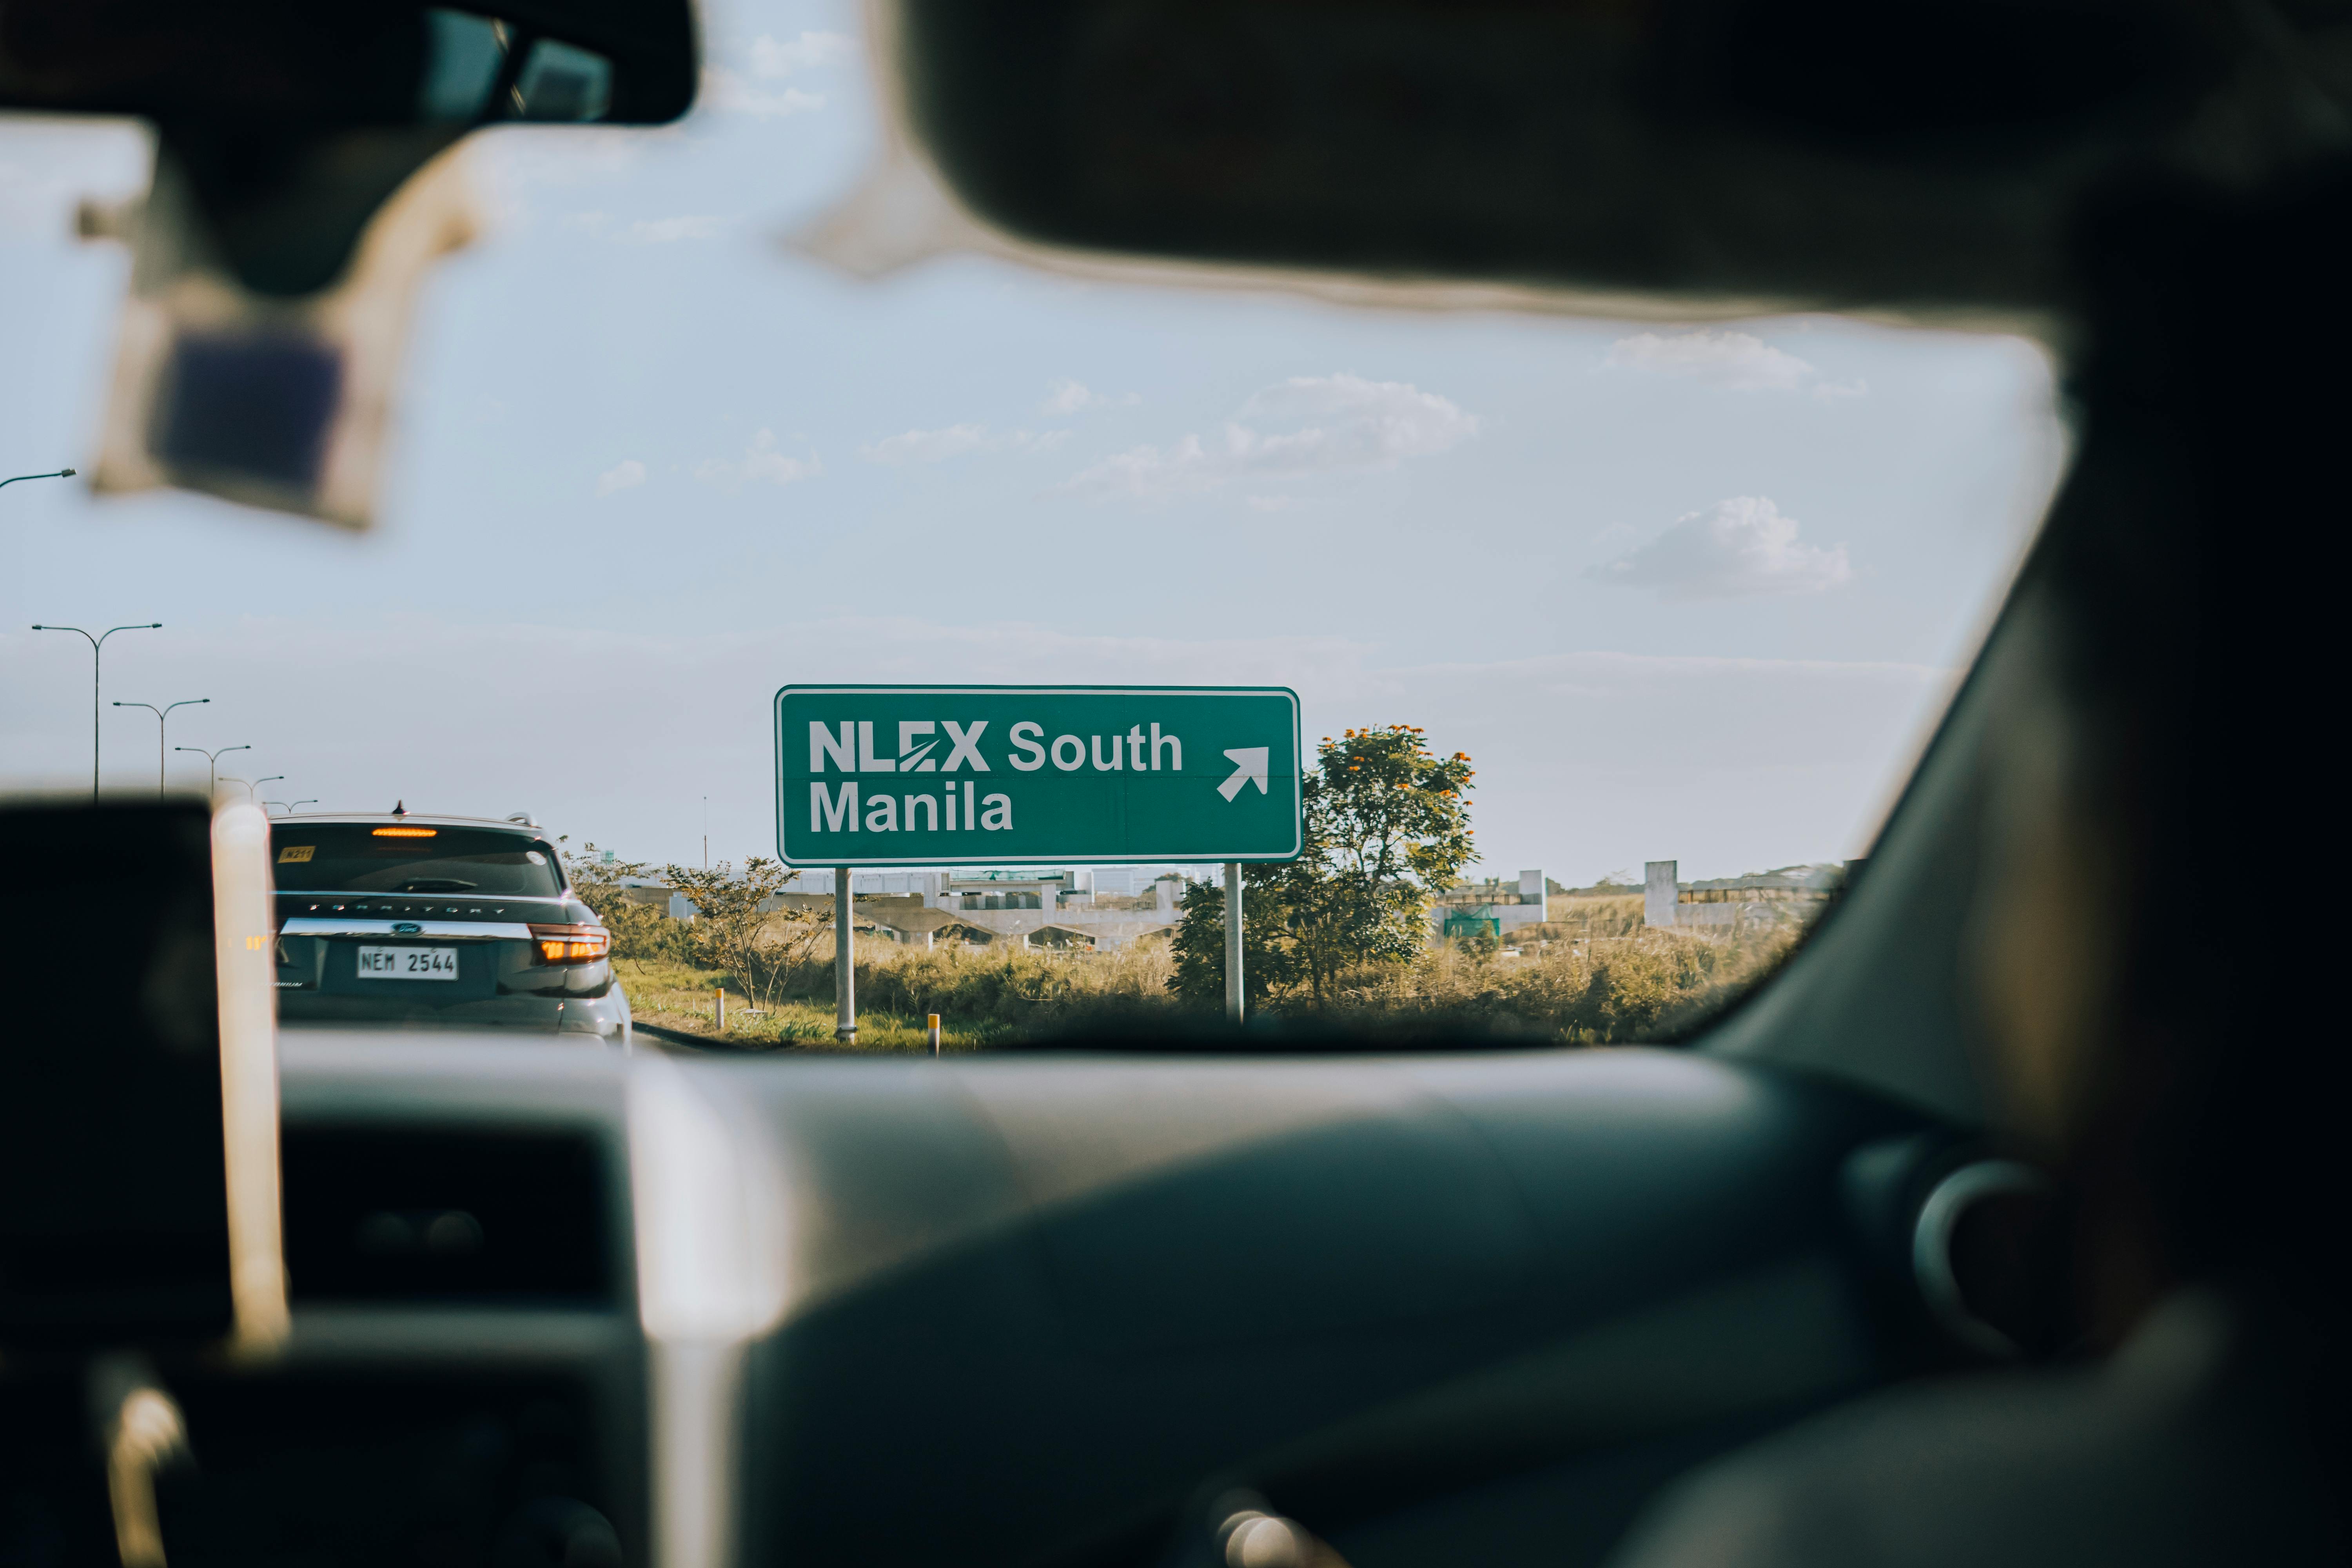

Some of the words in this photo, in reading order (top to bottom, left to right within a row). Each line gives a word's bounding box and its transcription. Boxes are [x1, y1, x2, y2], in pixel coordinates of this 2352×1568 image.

[809, 721, 991, 772] NLEX
[1008, 721, 1182, 771] South
[810, 781, 1013, 832] Manila
[361, 953, 395, 971] NEM
[408, 954, 454, 972] 2544
